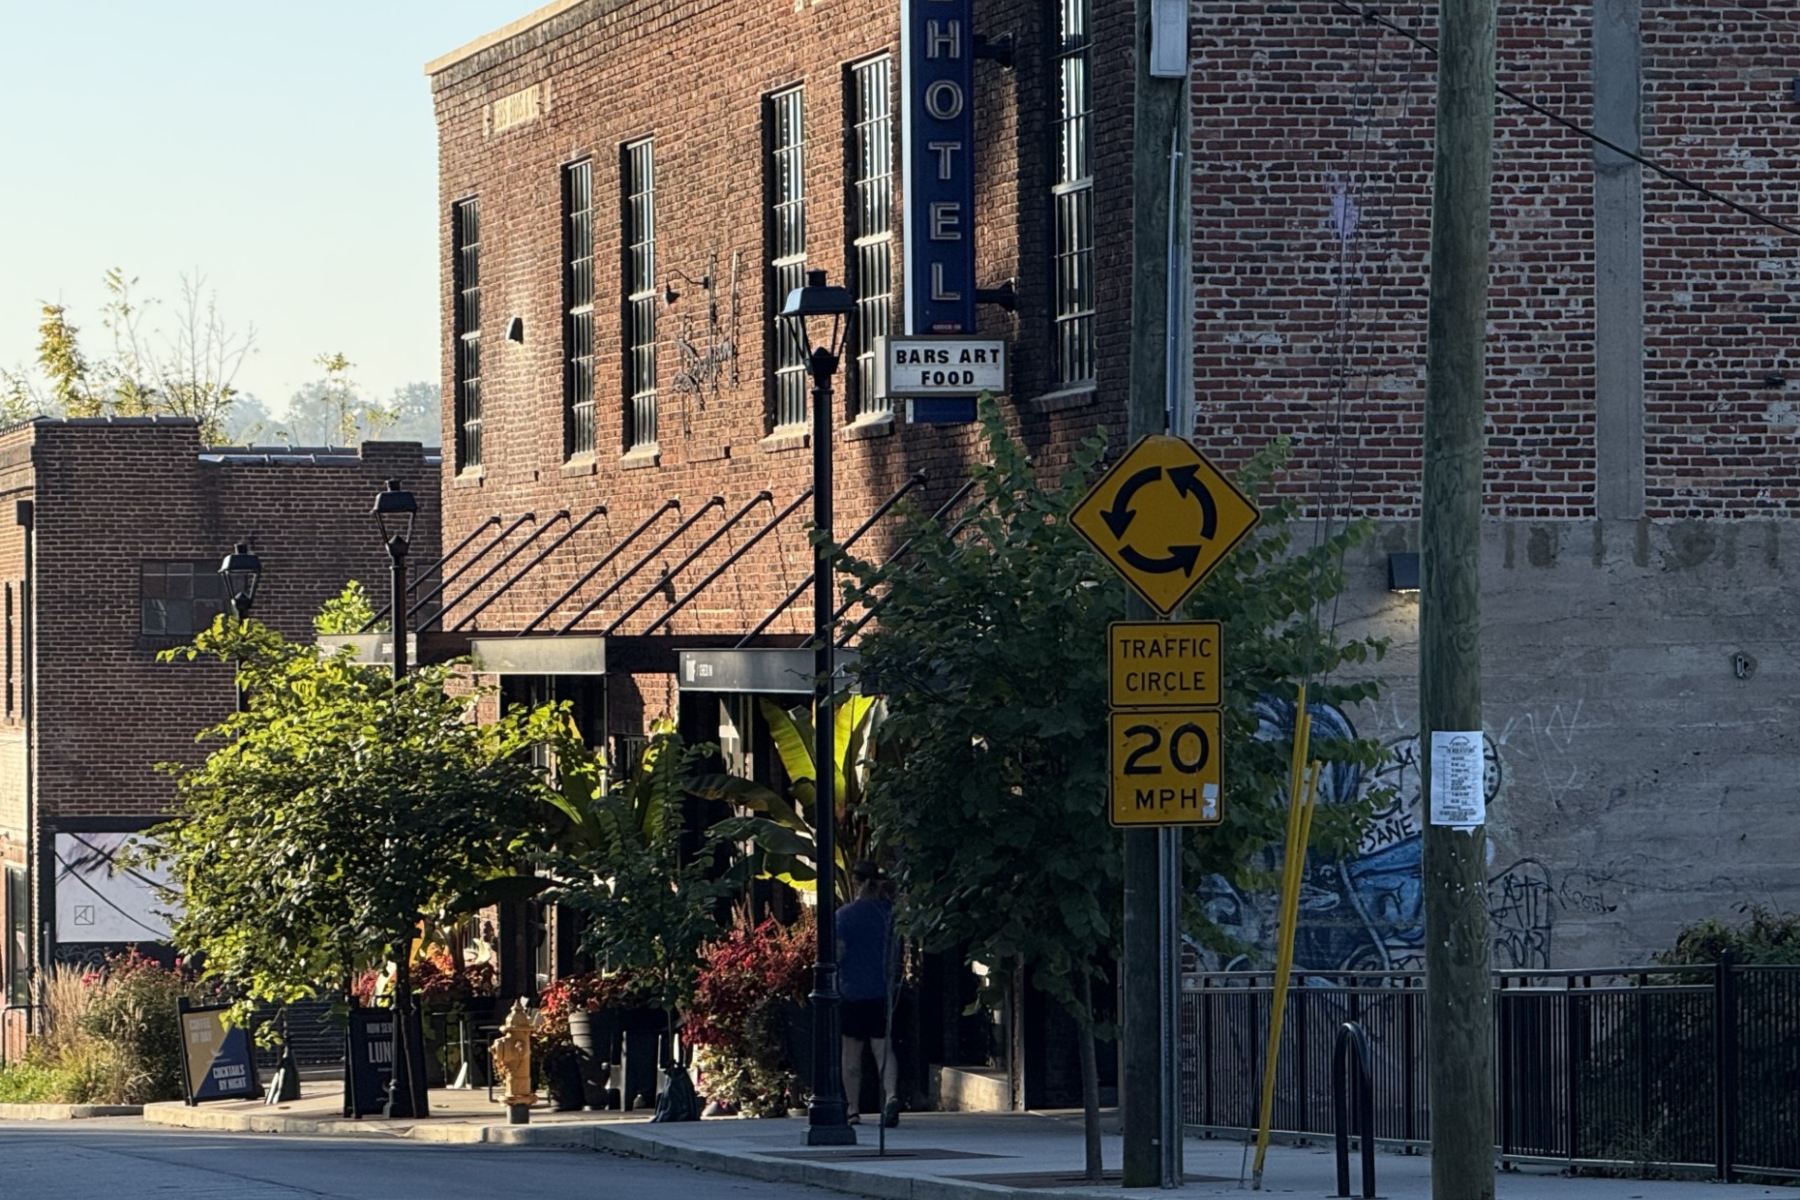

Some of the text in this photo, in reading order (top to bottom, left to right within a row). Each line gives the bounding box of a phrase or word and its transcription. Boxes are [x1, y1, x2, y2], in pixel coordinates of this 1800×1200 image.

[925, 19, 963, 301] HOTEL
[896, 348, 1000, 365] BARS ART
[921, 370, 975, 386] FOOD
[1119, 638, 1212, 659] TRAFFIC
[1126, 671, 1206, 692] CIRCLE
[1123, 723, 1210, 775] 20
[1136, 788, 1197, 810] MPH
[368, 1041, 394, 1063] LUN
[212, 1064, 246, 1079] COCKTAILS
[218, 1077, 247, 1091] BY NIGHT
